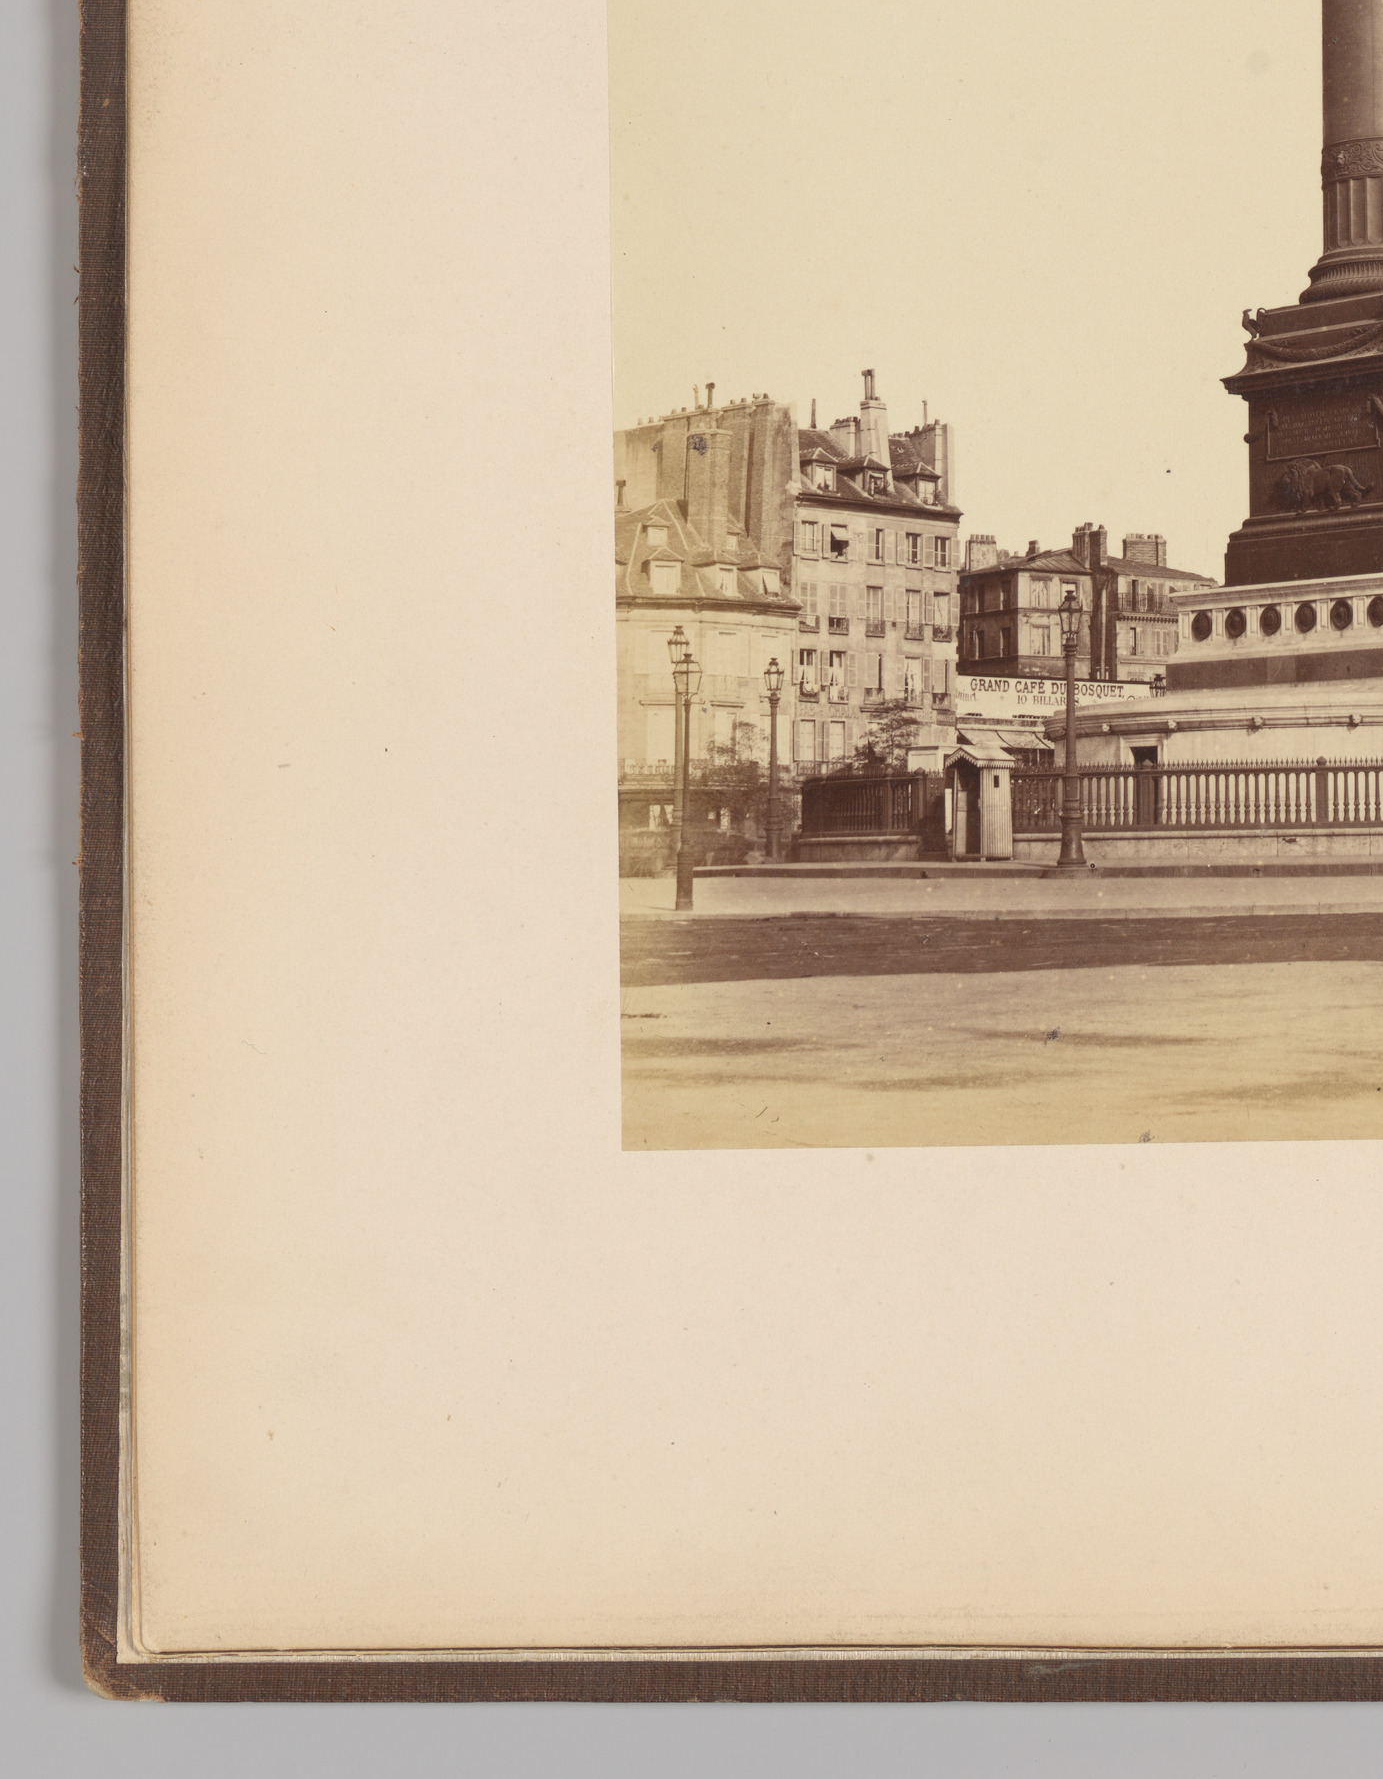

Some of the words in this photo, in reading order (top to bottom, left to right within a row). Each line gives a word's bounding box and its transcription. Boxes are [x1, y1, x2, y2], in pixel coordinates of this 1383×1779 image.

[970, 678, 1010, 693] GRAND
[1015, 679, 1046, 694] CAFÉ
[1051, 682, 1068, 695] DU
[1017, 695, 1028, 705] 10
[1033, 696, 1080, 708] BILLARS
